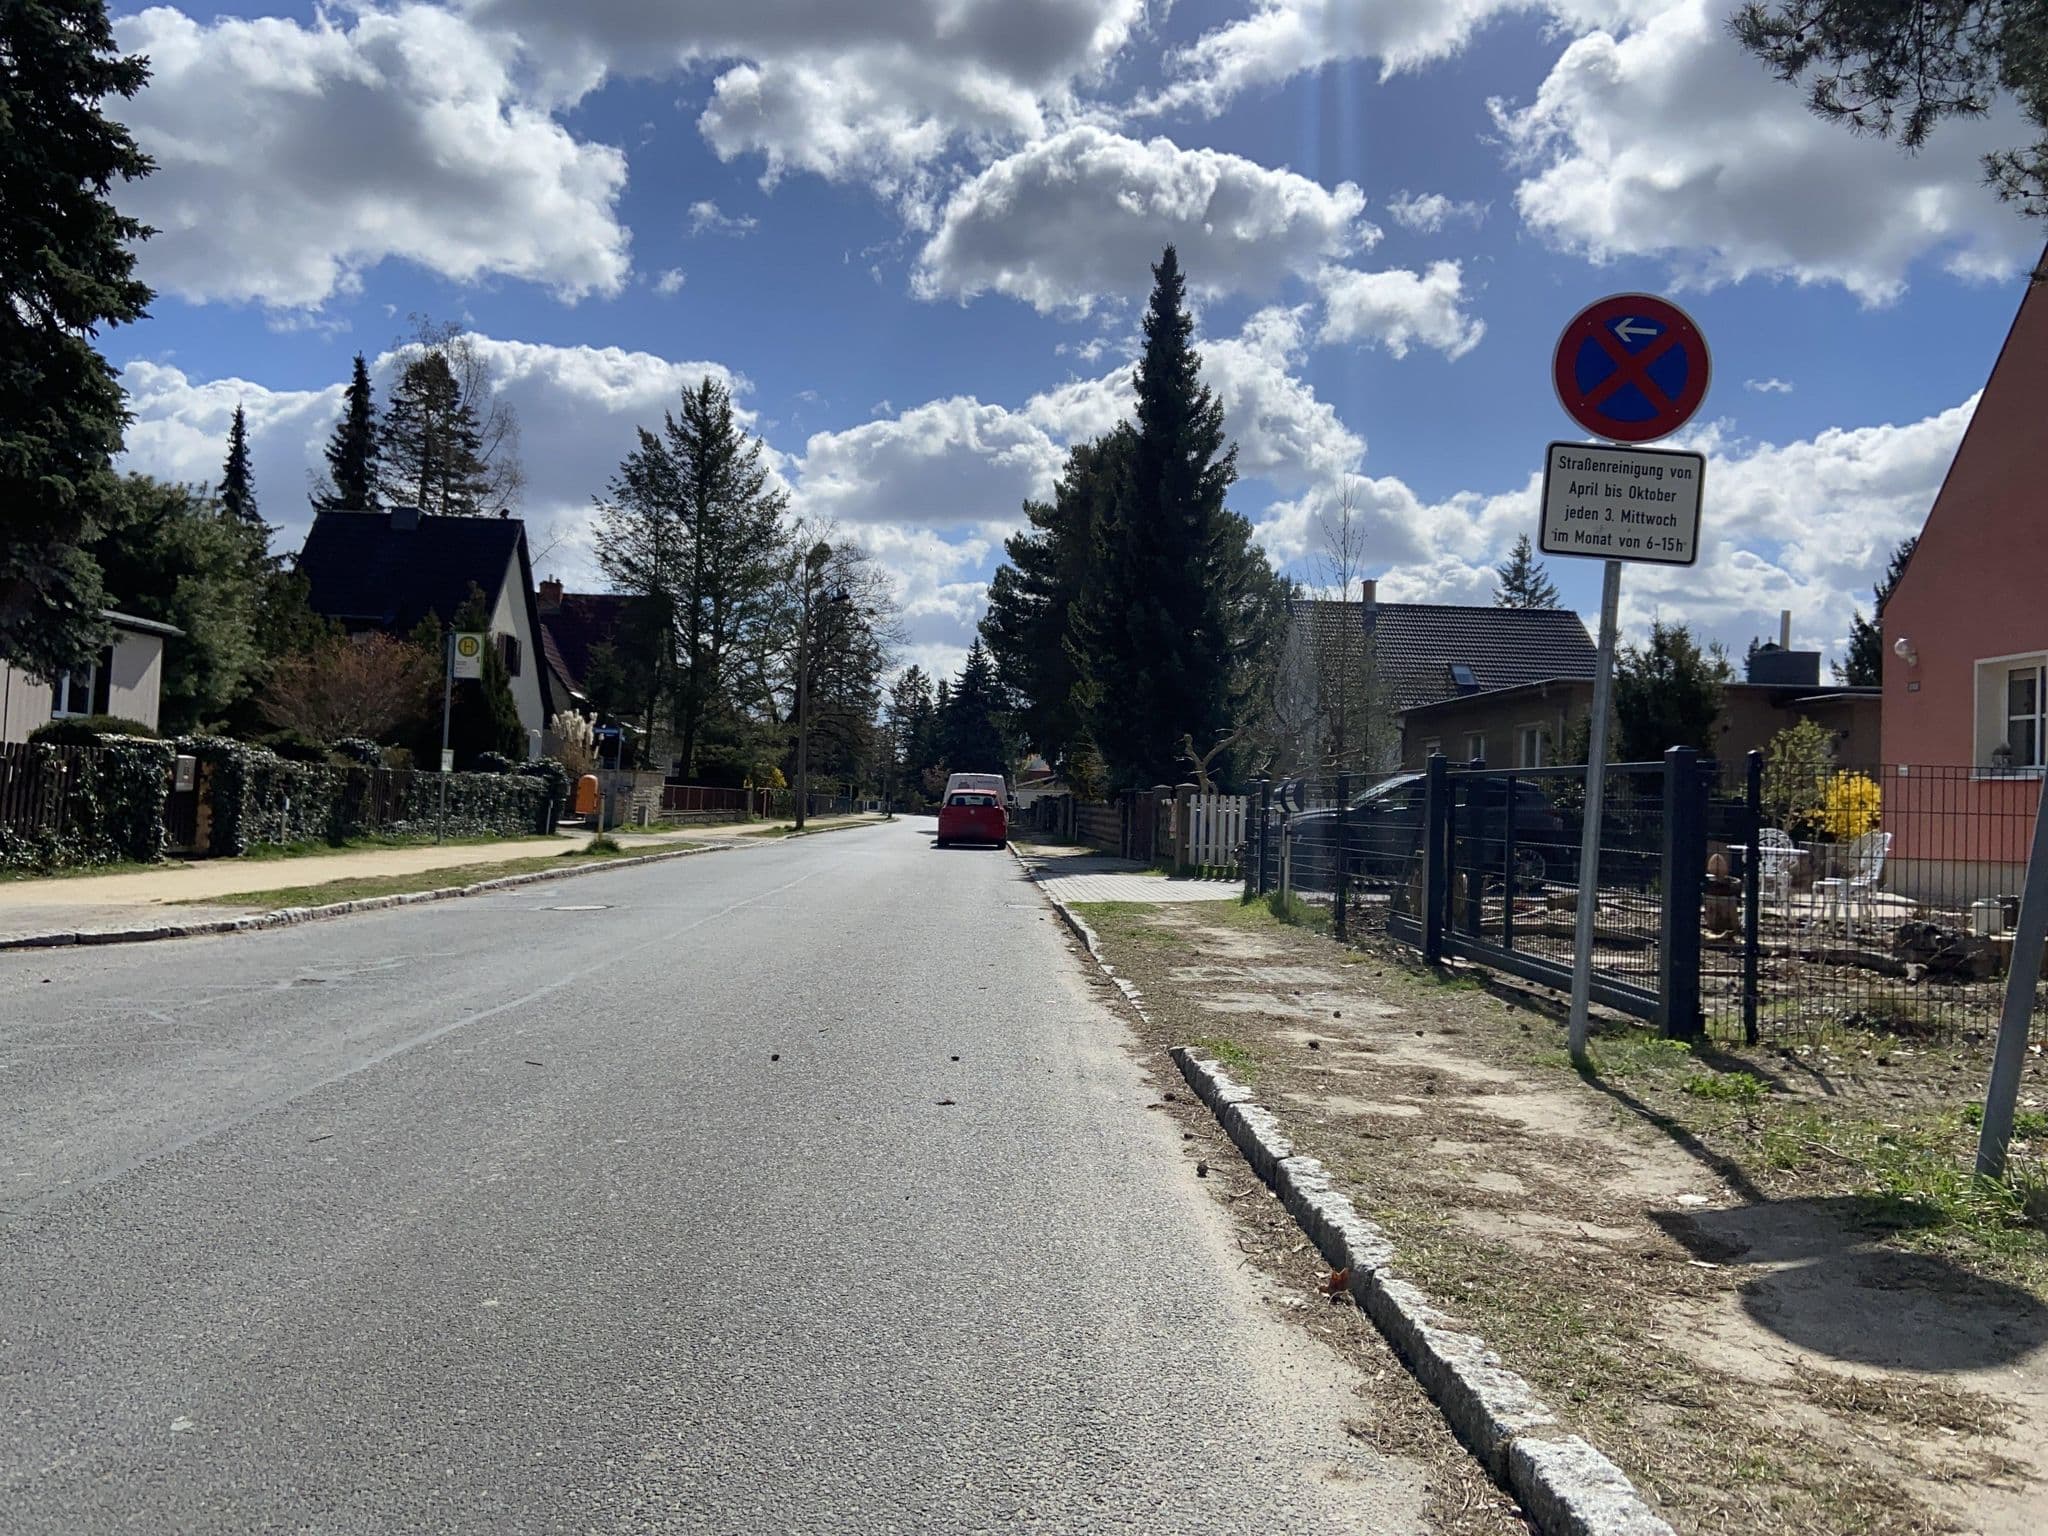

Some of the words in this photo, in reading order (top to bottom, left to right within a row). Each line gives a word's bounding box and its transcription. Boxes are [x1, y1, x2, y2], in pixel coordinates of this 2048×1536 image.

[1558, 456, 1663, 479] Straßenreinigung
[1670, 467, 1692, 479] von
[1569, 481, 1598, 498] April
[1605, 485, 1622, 498] bis
[1628, 486, 1677, 502] Oktober
[1564, 505, 1598, 521] jeden
[1605, 508, 1614, 522] 3.
[1621, 509, 1677, 527] Mittwoch
[1553, 528, 1568, 542] im
[1575, 530, 1612, 546] Monat
[1619, 536, 1640, 548] von
[1646, 536, 1683, 552] 6-15h
